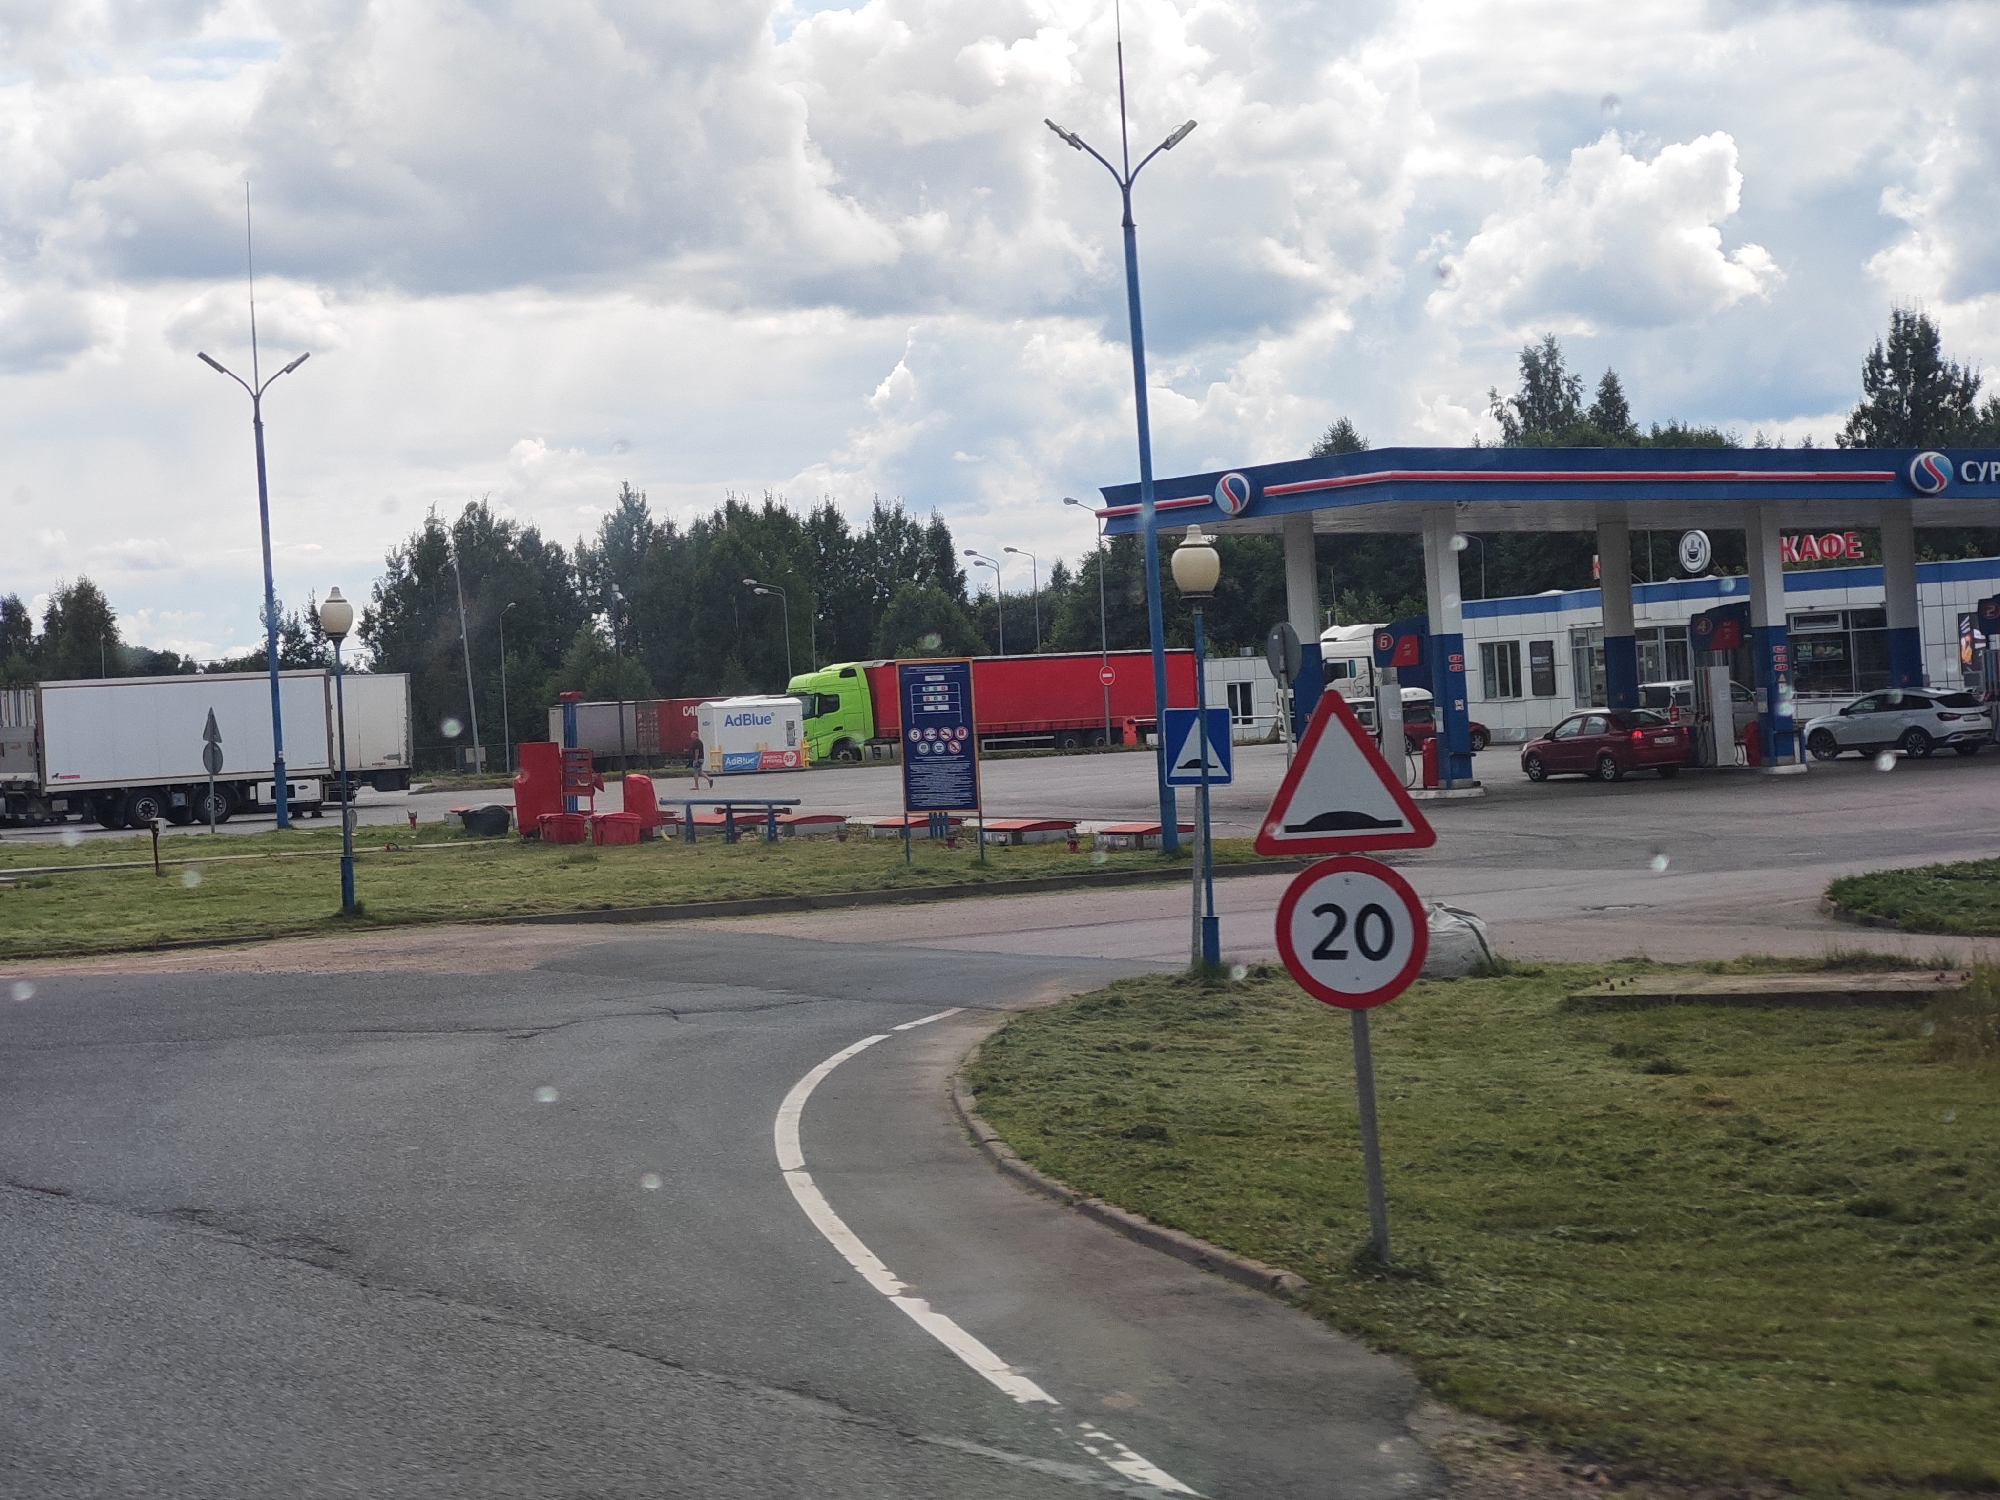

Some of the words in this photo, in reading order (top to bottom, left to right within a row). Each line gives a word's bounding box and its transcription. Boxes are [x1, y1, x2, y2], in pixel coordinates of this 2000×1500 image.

[1780, 531, 1864, 563] КАФЕ
[1380, 635, 1389, 648] 6
[1311, 902, 1395, 961] 20
